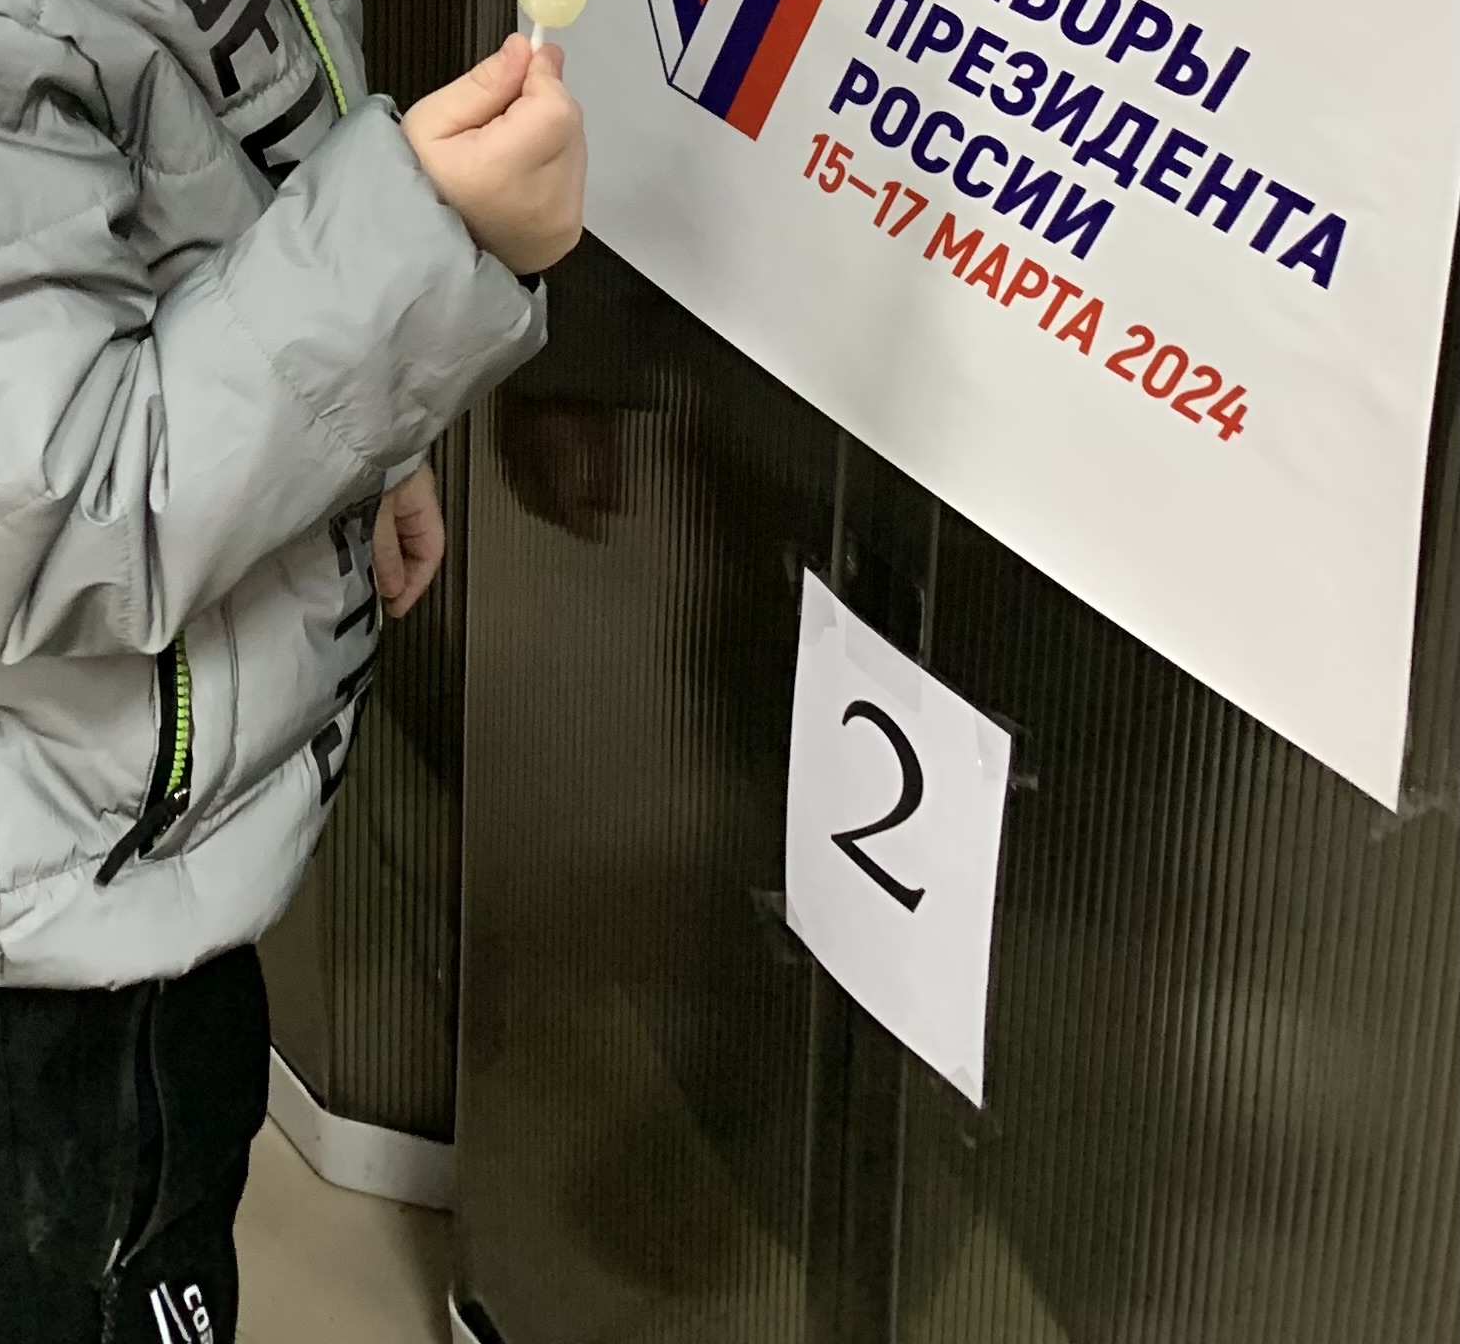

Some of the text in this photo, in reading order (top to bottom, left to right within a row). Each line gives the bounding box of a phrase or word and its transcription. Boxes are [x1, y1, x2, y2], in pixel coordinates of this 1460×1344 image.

[828, 58, 1115, 260] РОССИИ
[924, 212, 1105, 356] МАРТА
[1105, 324, 1249, 442] 2024
[830, 700, 926, 913] 2
